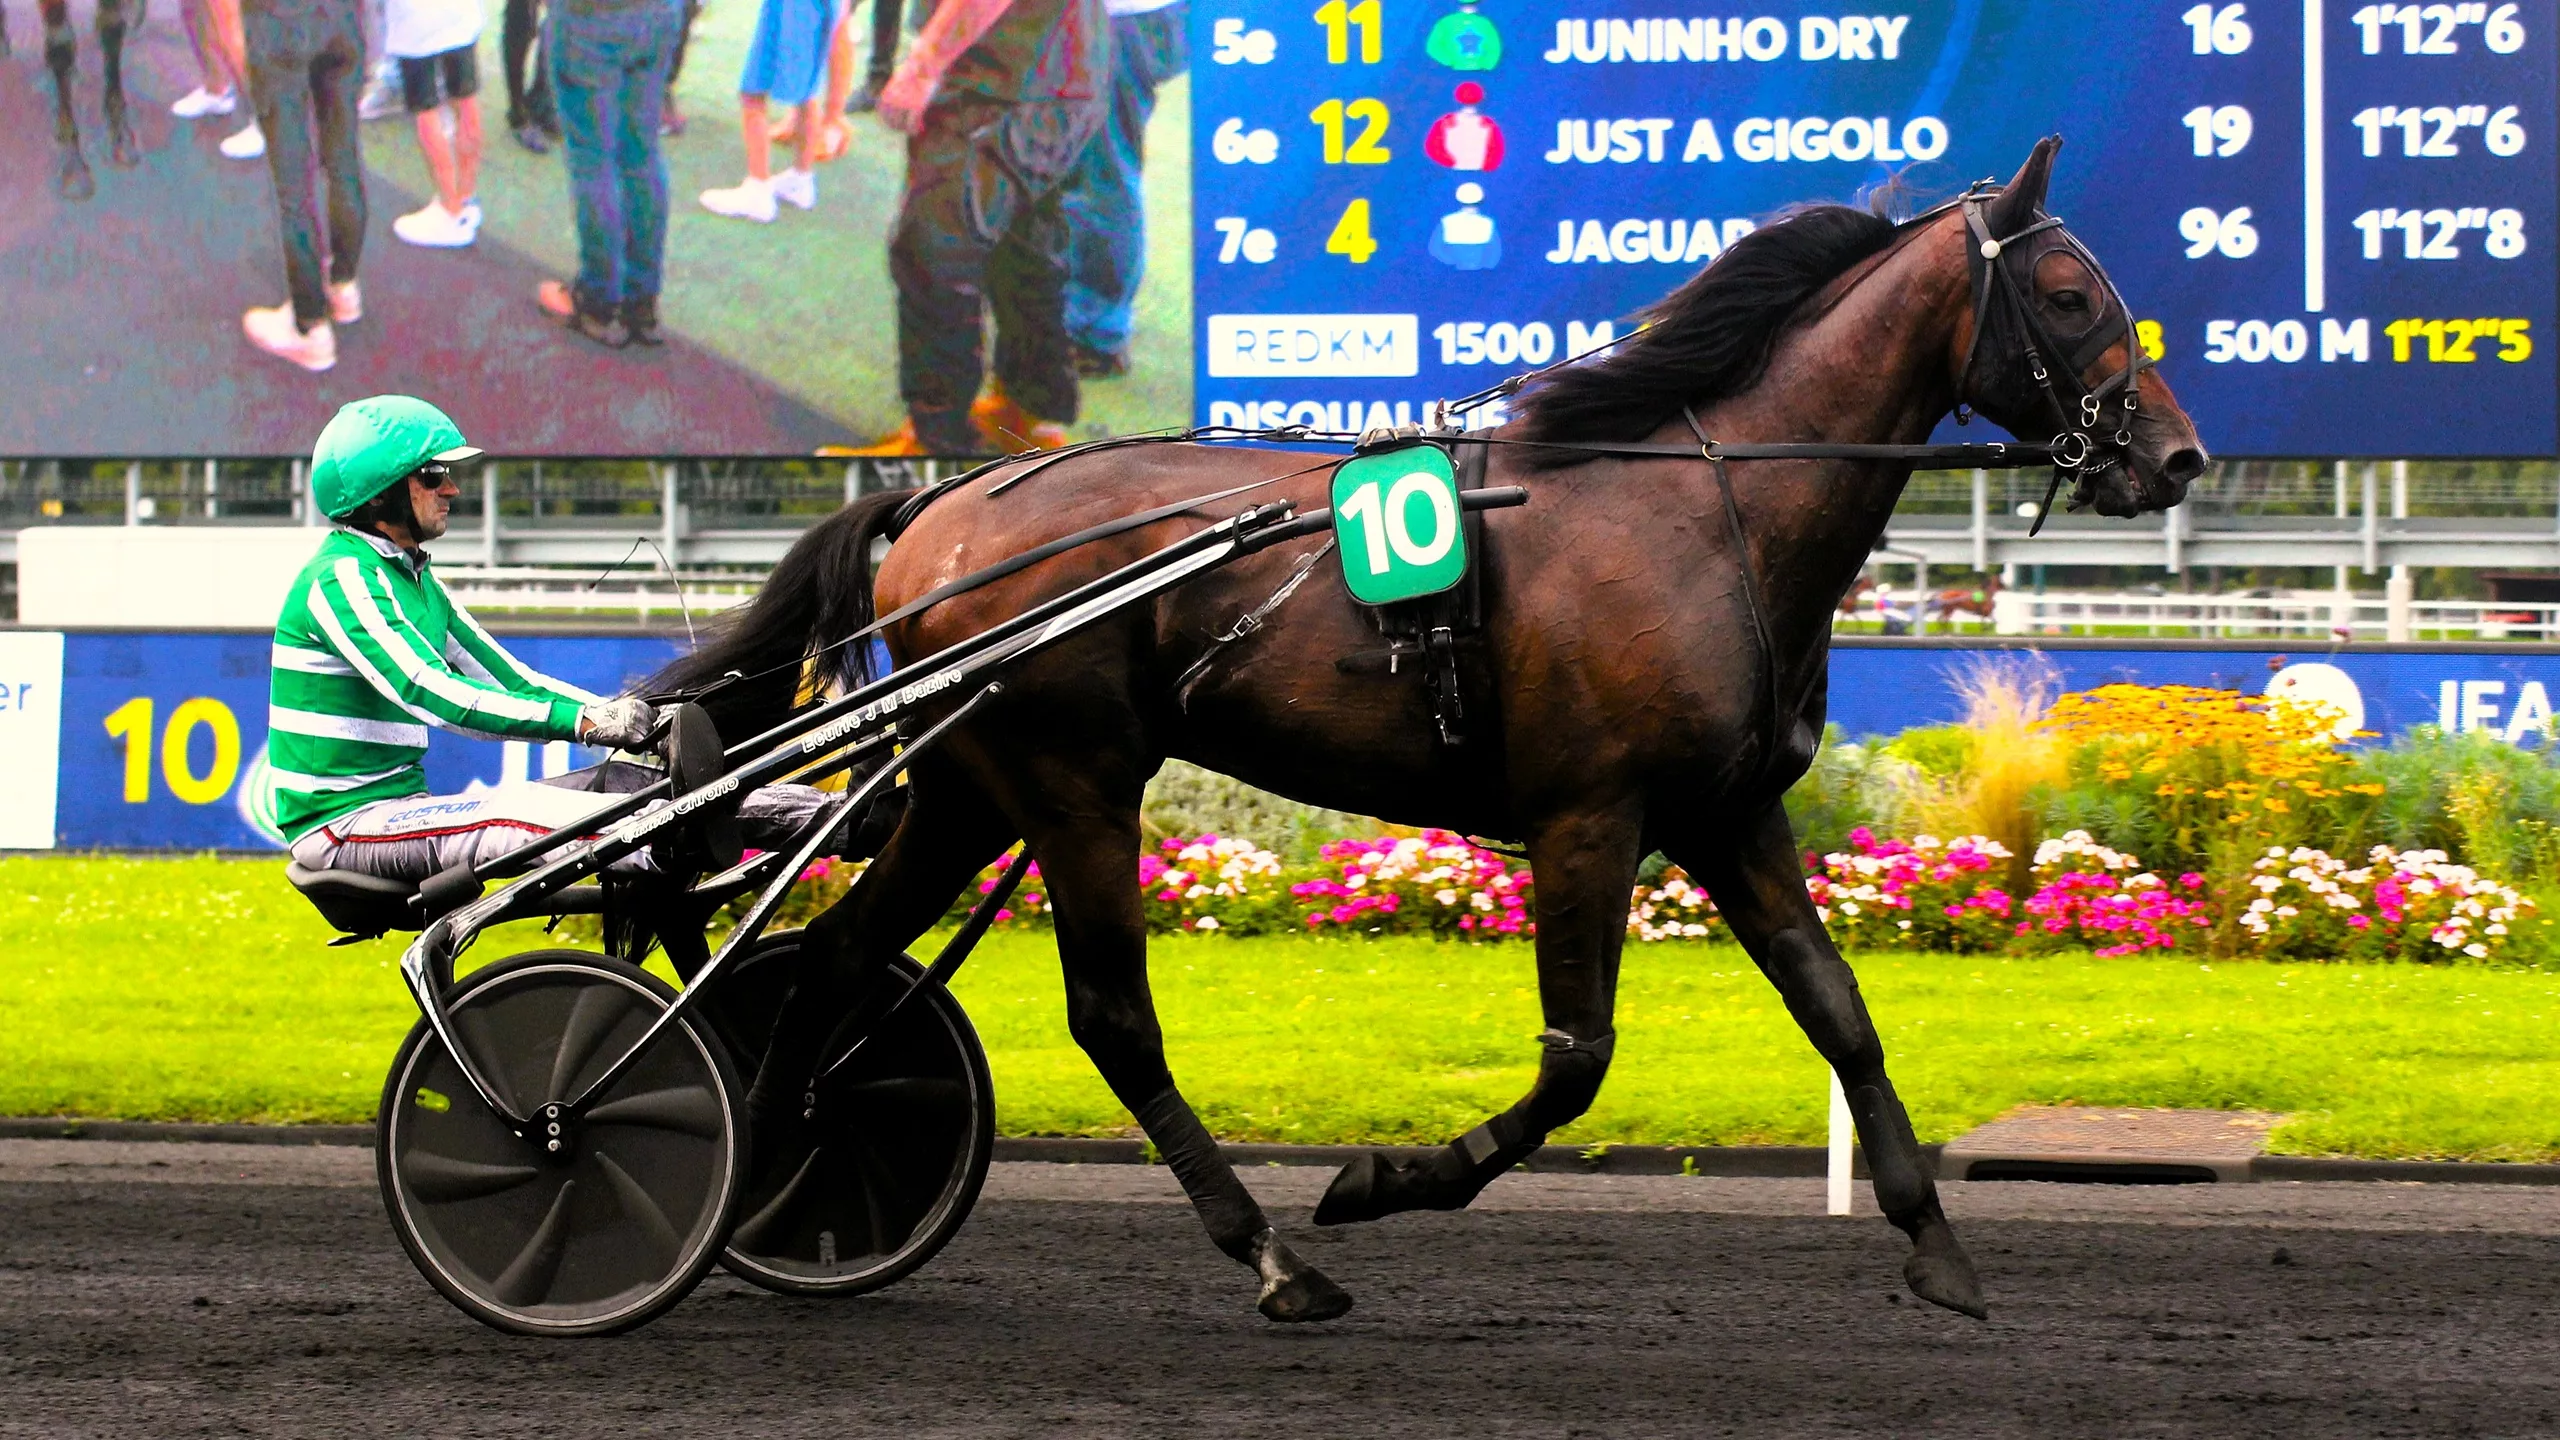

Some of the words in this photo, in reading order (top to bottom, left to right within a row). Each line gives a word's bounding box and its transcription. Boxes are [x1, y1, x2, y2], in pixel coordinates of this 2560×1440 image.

[1212, 18, 1278, 65] 5e
[1313, 0, 1383, 64] 11
[1544, 16, 1789, 64] JUNINHO
[1799, 15, 1910, 62] DRY
[2181, 2, 2254, 55] 16
[1212, 117, 1280, 165] 6e
[1309, 97, 1391, 164] 12
[1544, 118, 1674, 164] JUST
[1682, 118, 1724, 163] A
[1733, 116, 1949, 162] GIGOLO
[2181, 104, 2254, 157] 19
[1213, 217, 1278, 264] 7e
[1325, 198, 1378, 264] 4
[2178, 206, 2260, 259] 96
[1236, 329, 1394, 363] REDKM
[1432, 321, 1555, 365] 1500
[1566, 320, 1615, 362] M
[2204, 319, 2308, 363] 500
[2320, 318, 2370, 363] M
[1338, 471, 1457, 576] 10
[802, 714, 861, 753] Ecurie
[865, 705, 877, 721] J
[881, 693, 898, 715] M
[902, 668, 963, 705] Bazire
[103, 697, 241, 804] 10
[675, 777, 739, 815] Chrono
